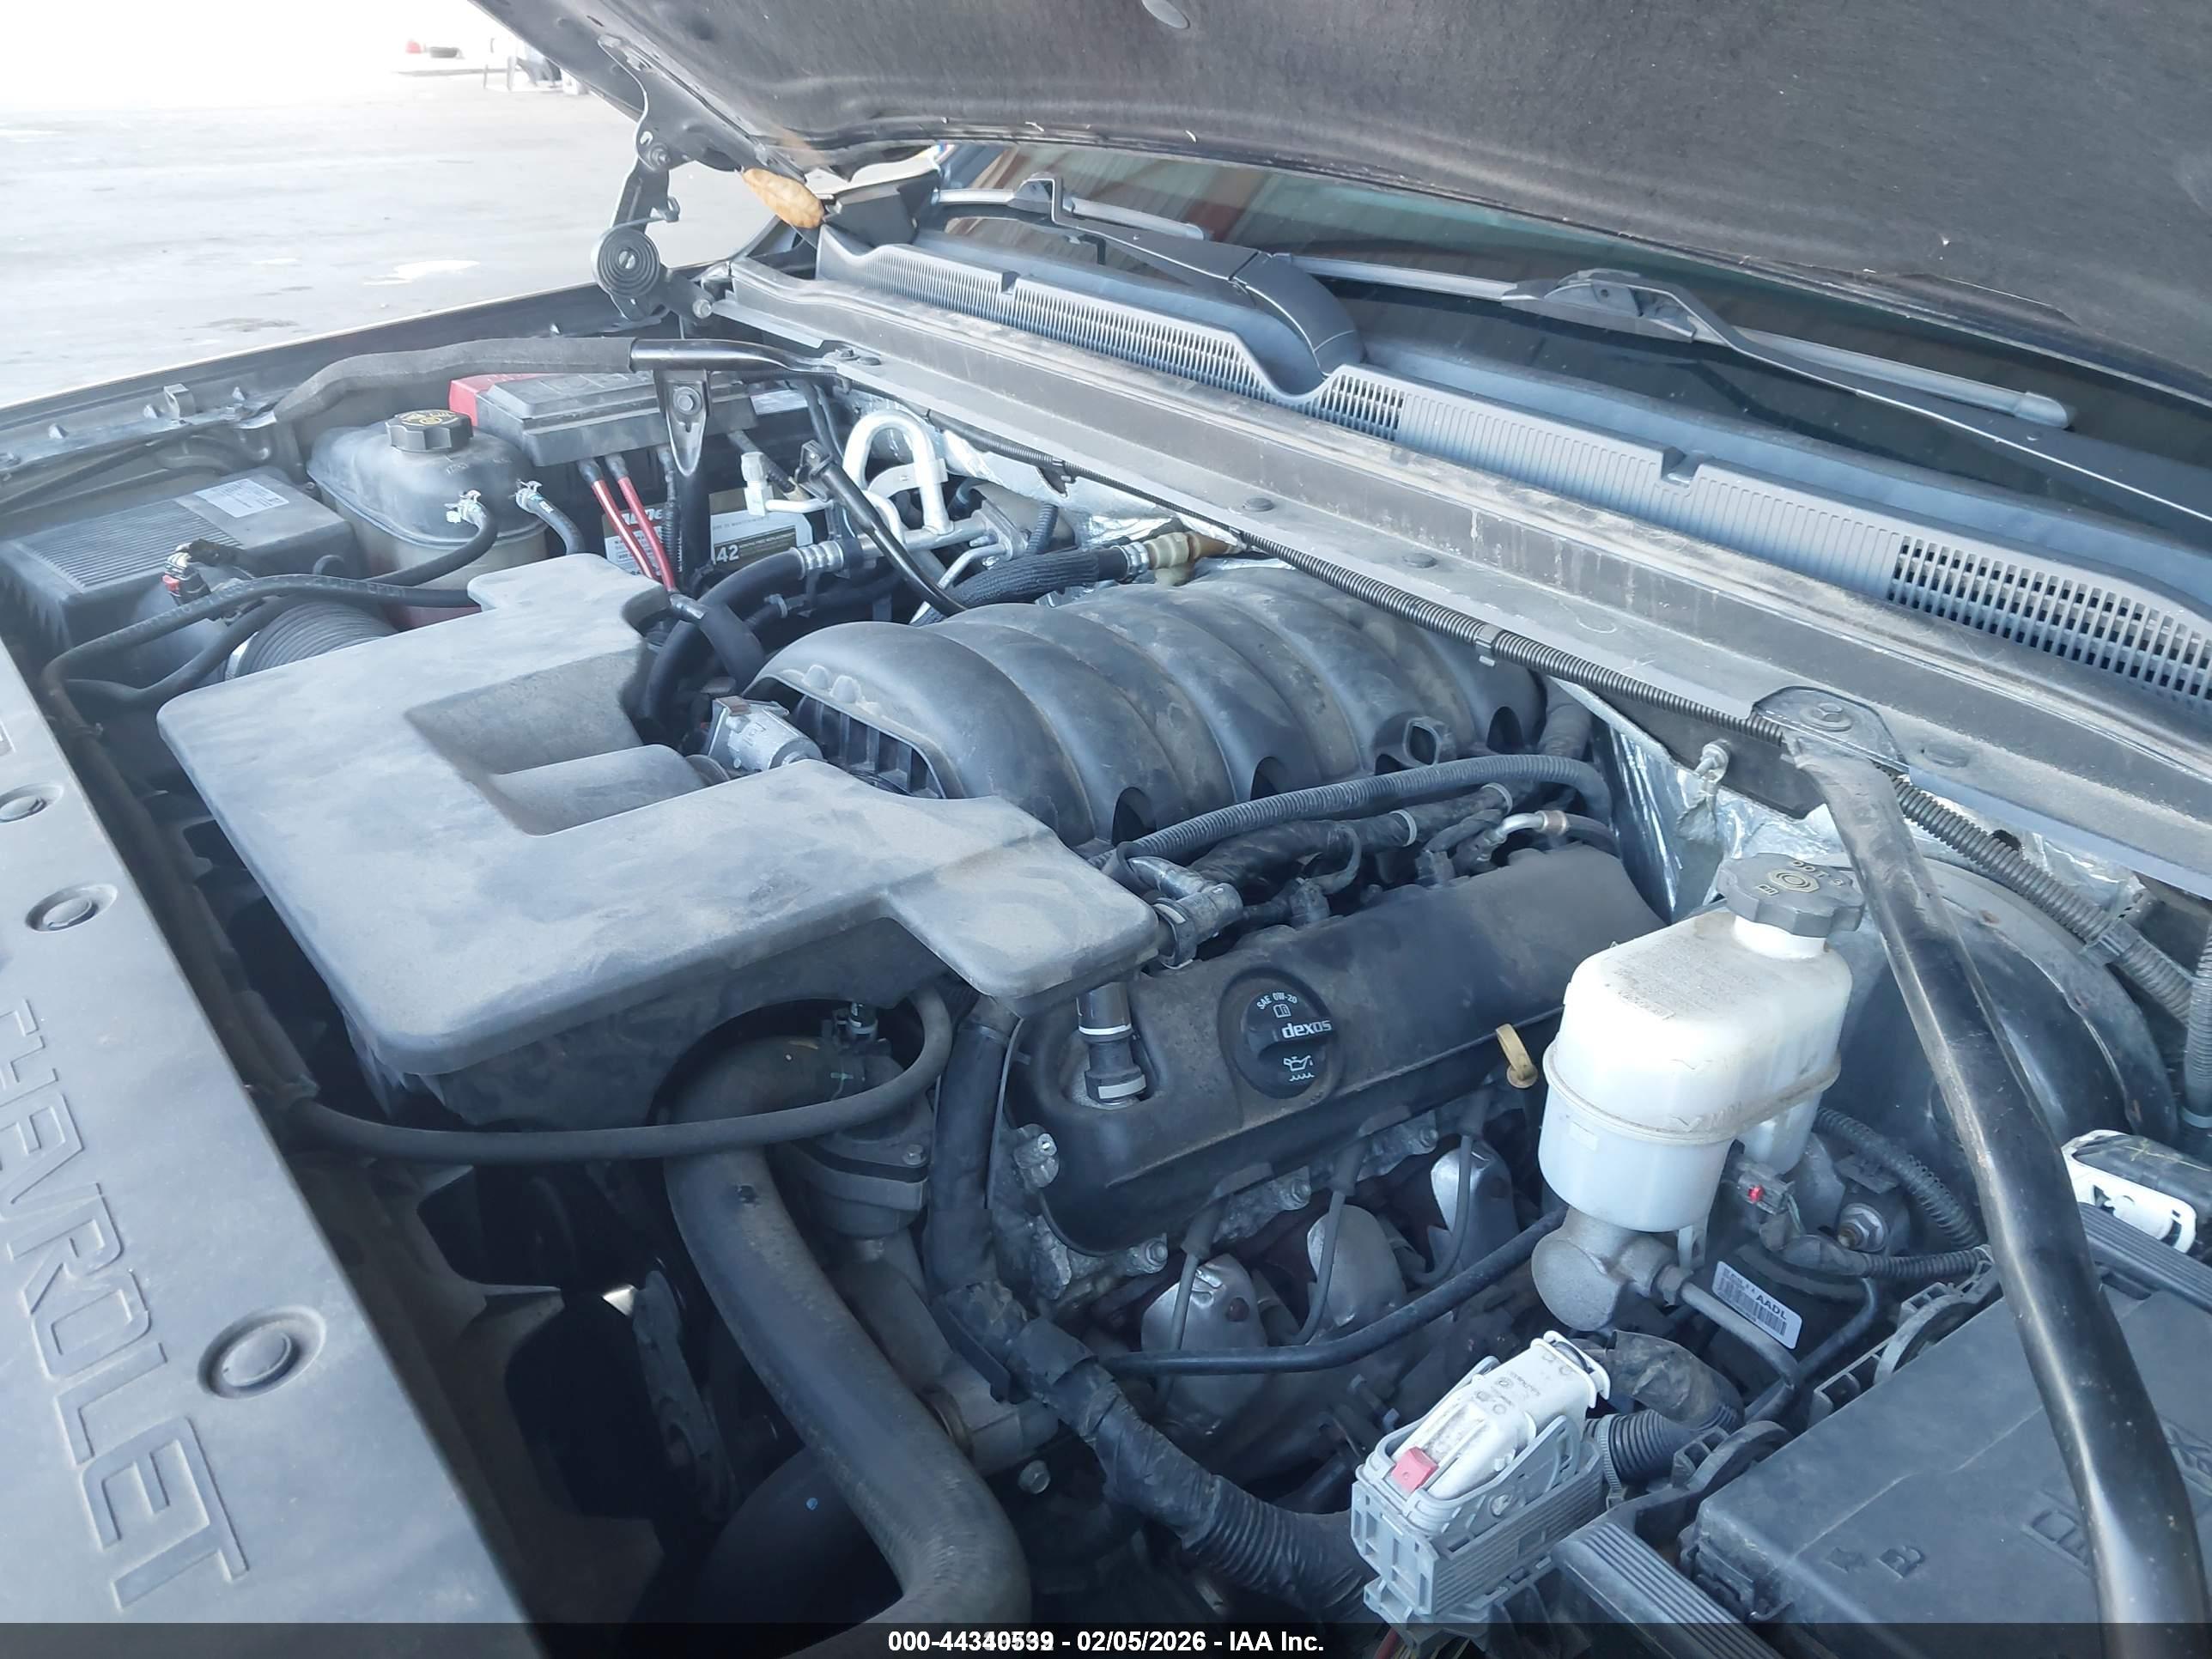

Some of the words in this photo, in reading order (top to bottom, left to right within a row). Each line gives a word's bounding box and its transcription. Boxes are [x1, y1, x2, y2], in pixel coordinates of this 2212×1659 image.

[716, 544, 739, 562] 42
[1256, 995, 1272, 1009] SAE
[1281, 1019, 1332, 1038] dexos
[1755, 1294, 1788, 1321] AADL
